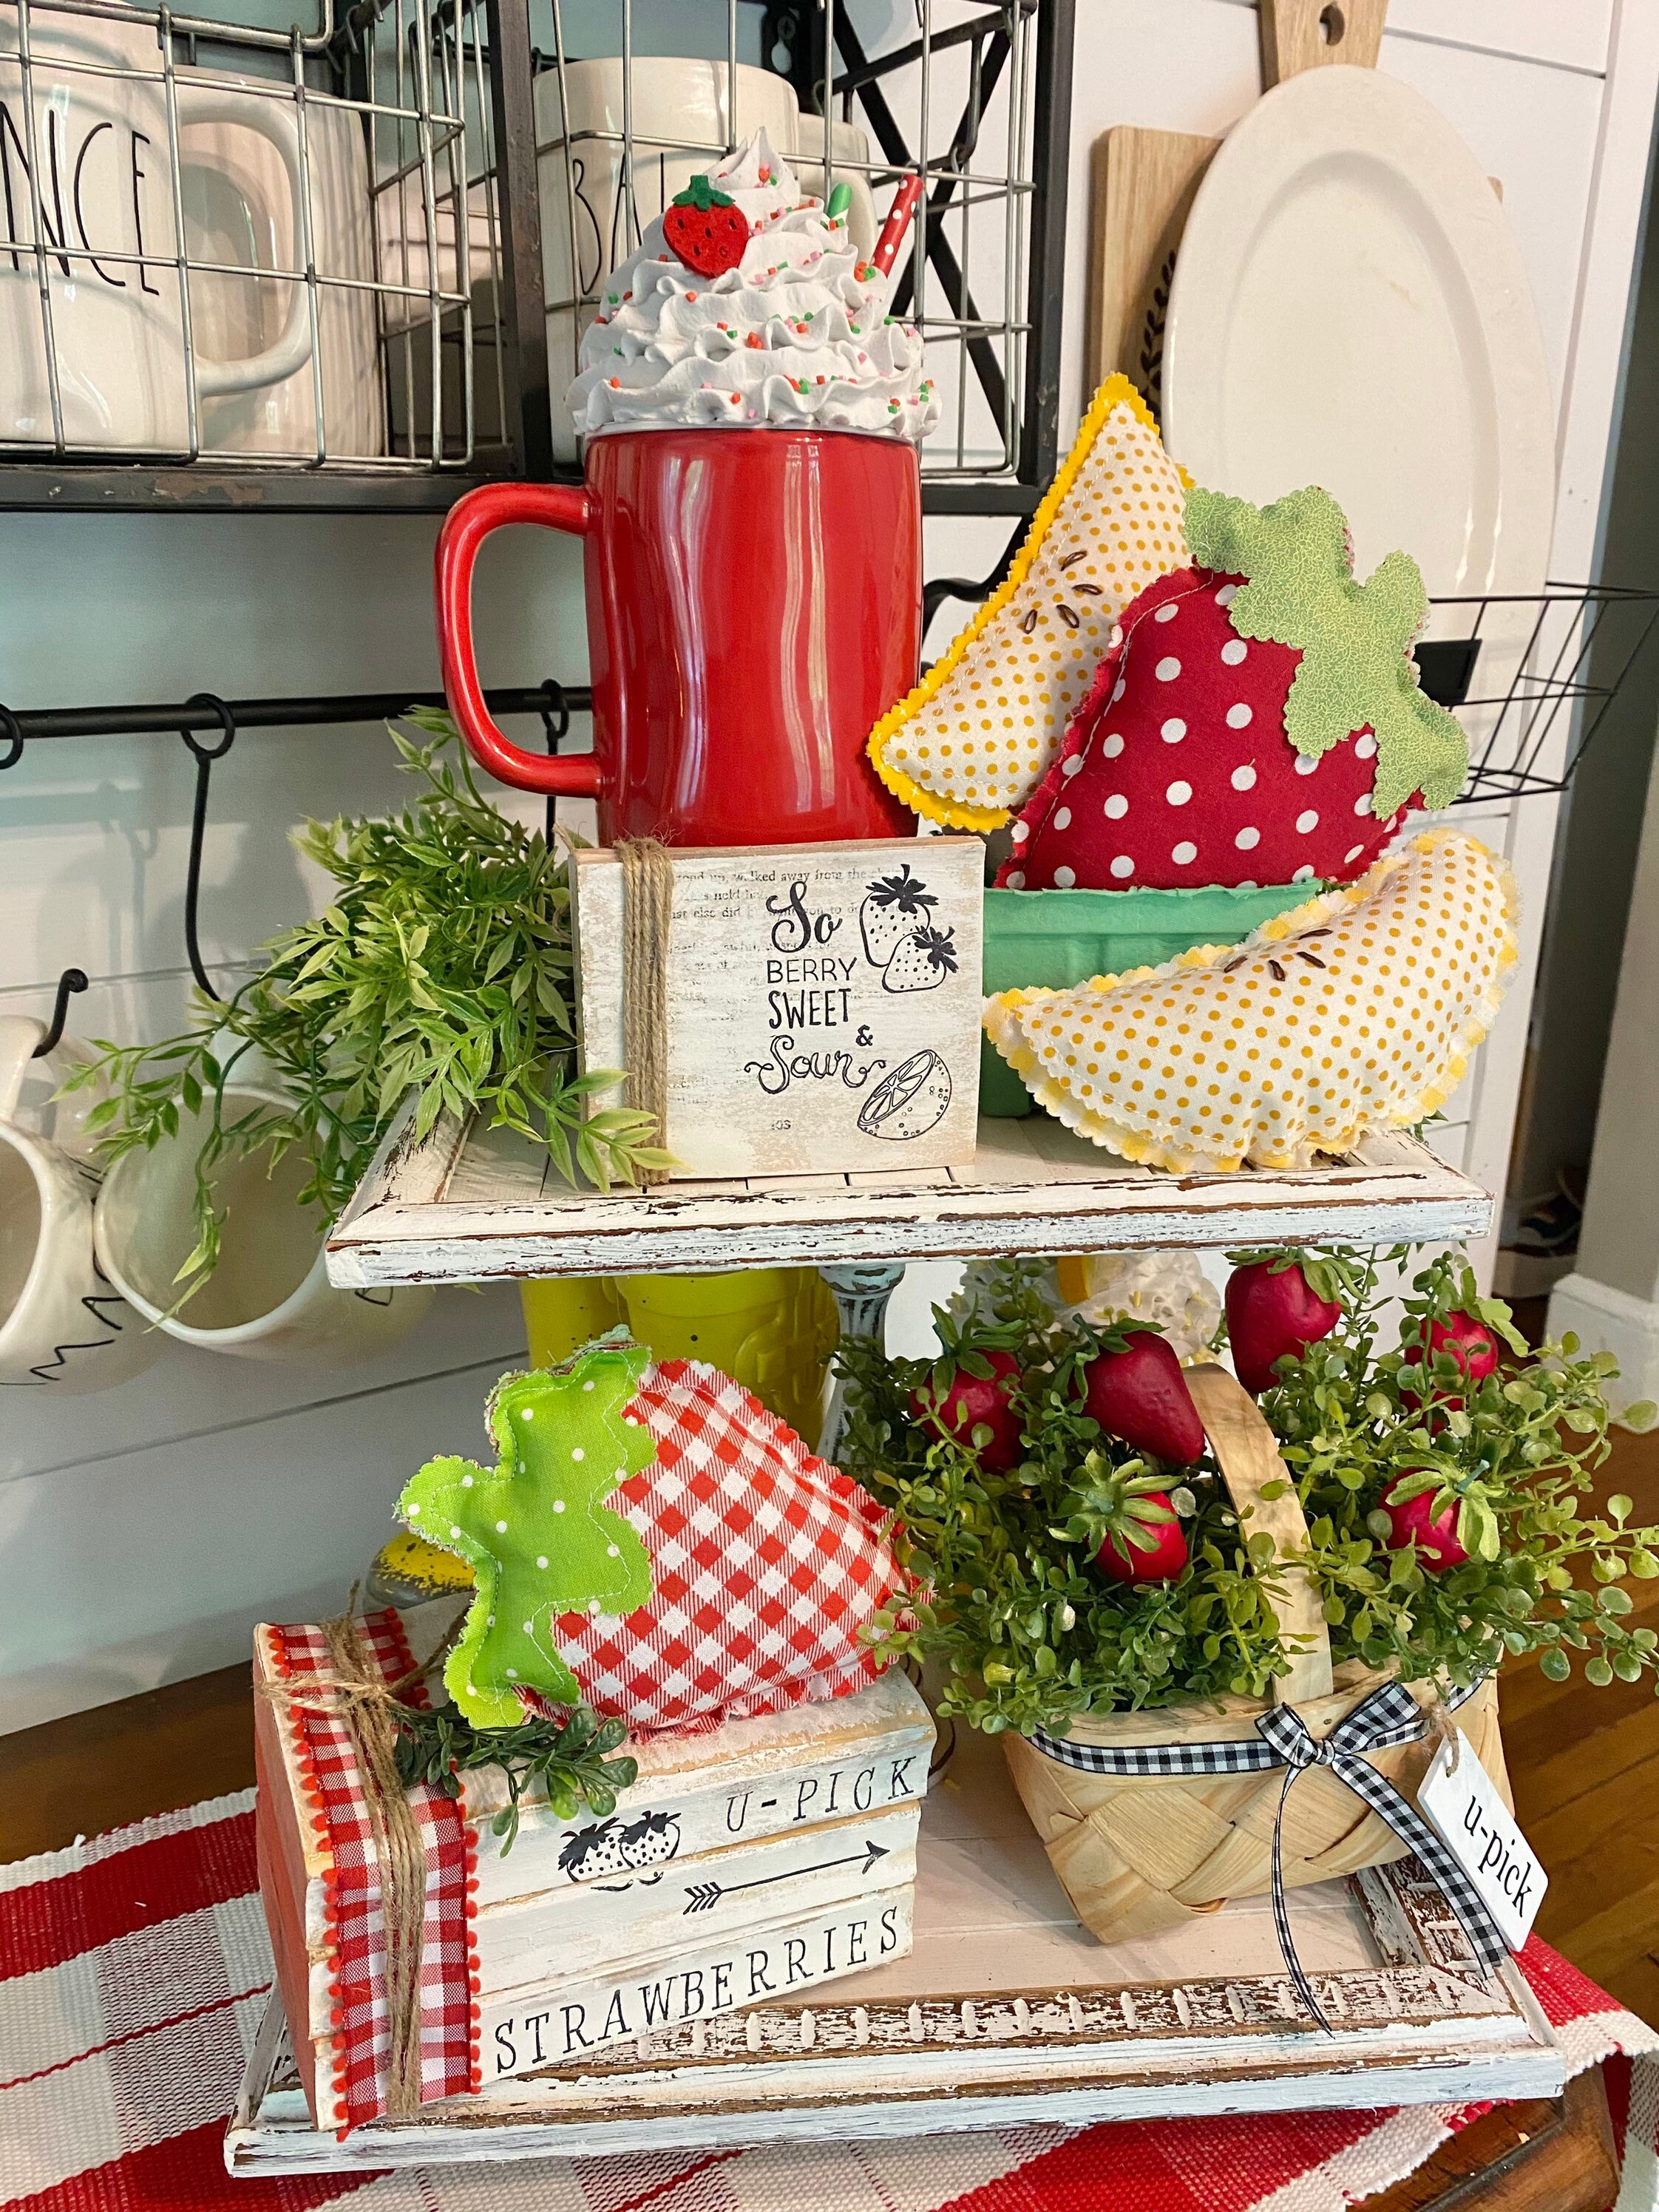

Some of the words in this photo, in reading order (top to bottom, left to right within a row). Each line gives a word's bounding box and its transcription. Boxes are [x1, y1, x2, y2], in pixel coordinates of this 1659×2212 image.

[766, 881, 843, 953] So
[767, 957, 858, 984] BERRY
[768, 988, 851, 1029] SWEET
[855, 1025, 874, 1046] &
[744, 1034, 886, 1095] Sour
[726, 1755, 918, 1833] U-PICK
[1463, 1794, 1533, 1918] u-pick
[495, 1906, 899, 2074] STRAWBERRIES
